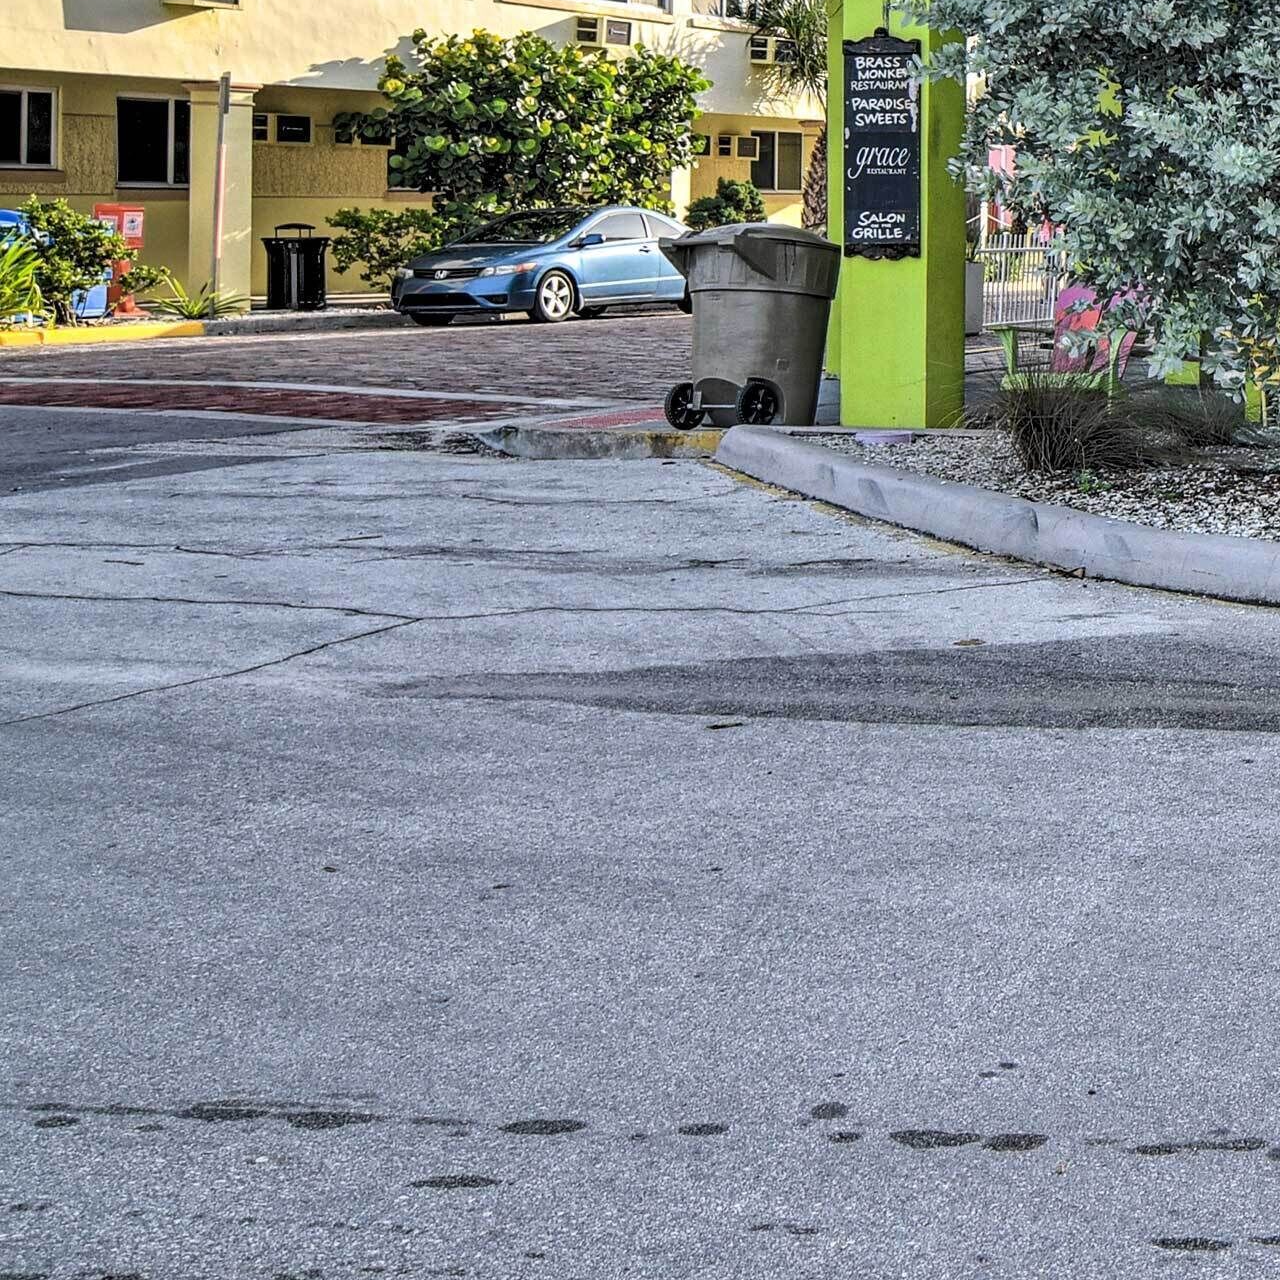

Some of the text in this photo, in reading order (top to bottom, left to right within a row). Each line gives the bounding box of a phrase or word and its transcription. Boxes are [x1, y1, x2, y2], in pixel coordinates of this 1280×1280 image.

[854, 56, 902, 70] BRASS
[850, 80, 908, 91] RESTAURAN
[851, 97, 912, 111] PARADISE
[854, 112, 909, 127] SWEETS
[847, 146, 911, 179] grace
[858, 210, 906, 226] SALON
[852, 227, 903, 239] GRILLE
